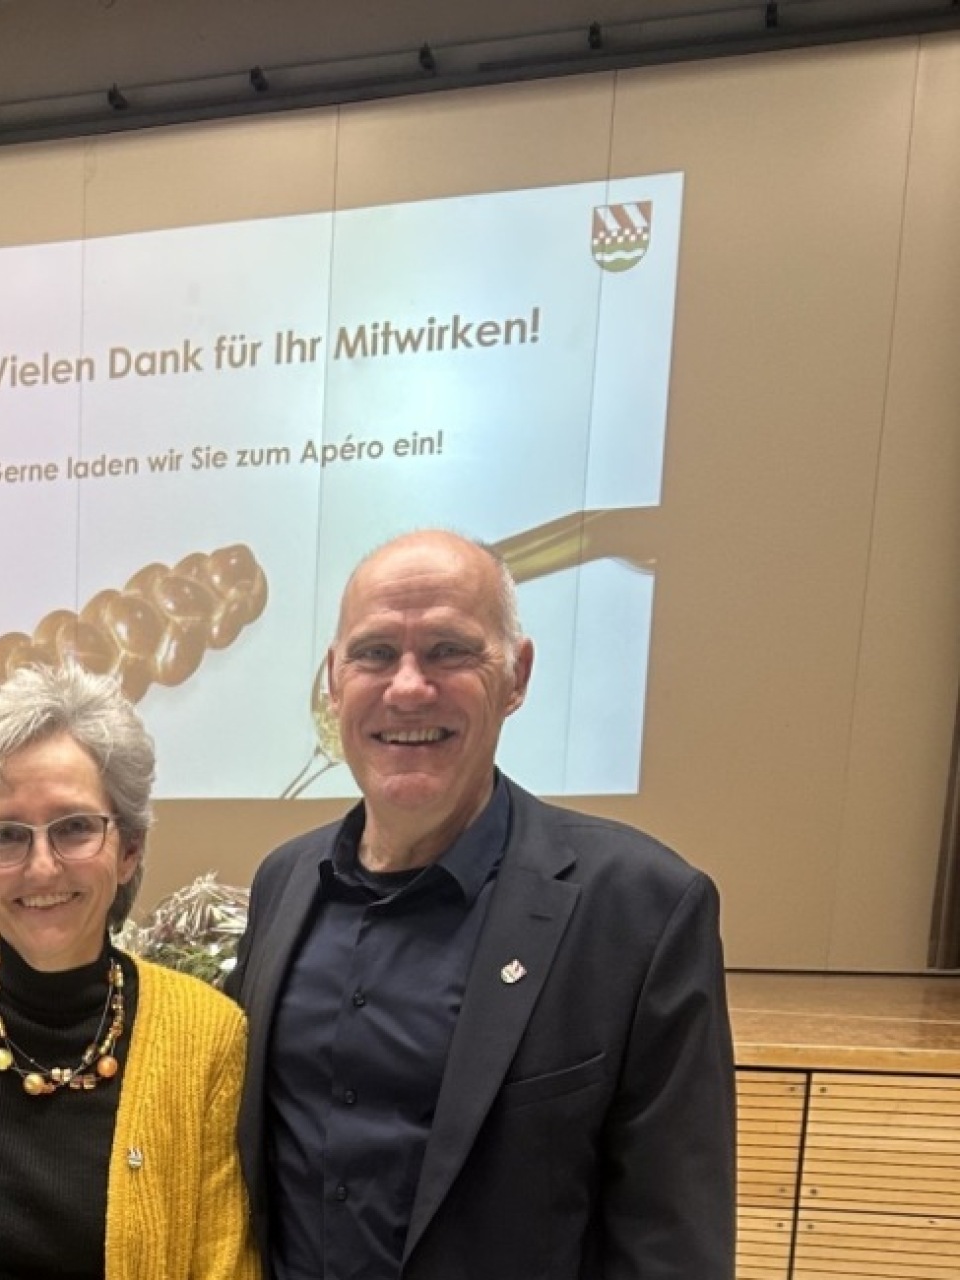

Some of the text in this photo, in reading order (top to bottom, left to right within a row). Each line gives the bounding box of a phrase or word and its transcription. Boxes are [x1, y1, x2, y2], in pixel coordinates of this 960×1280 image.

[108, 339, 204, 379] Dank
[214, 334, 263, 370] für
[275, 330, 322, 365] Ihr
[334, 306, 540, 360] Mitwirken!
[67, 454, 139, 479] laden
[147, 449, 184, 473] wir
[191, 445, 228, 470] Sie
[236, 447, 290, 468] zum
[300, 433, 384, 468] Apéro
[393, 429, 443, 457] ein!
